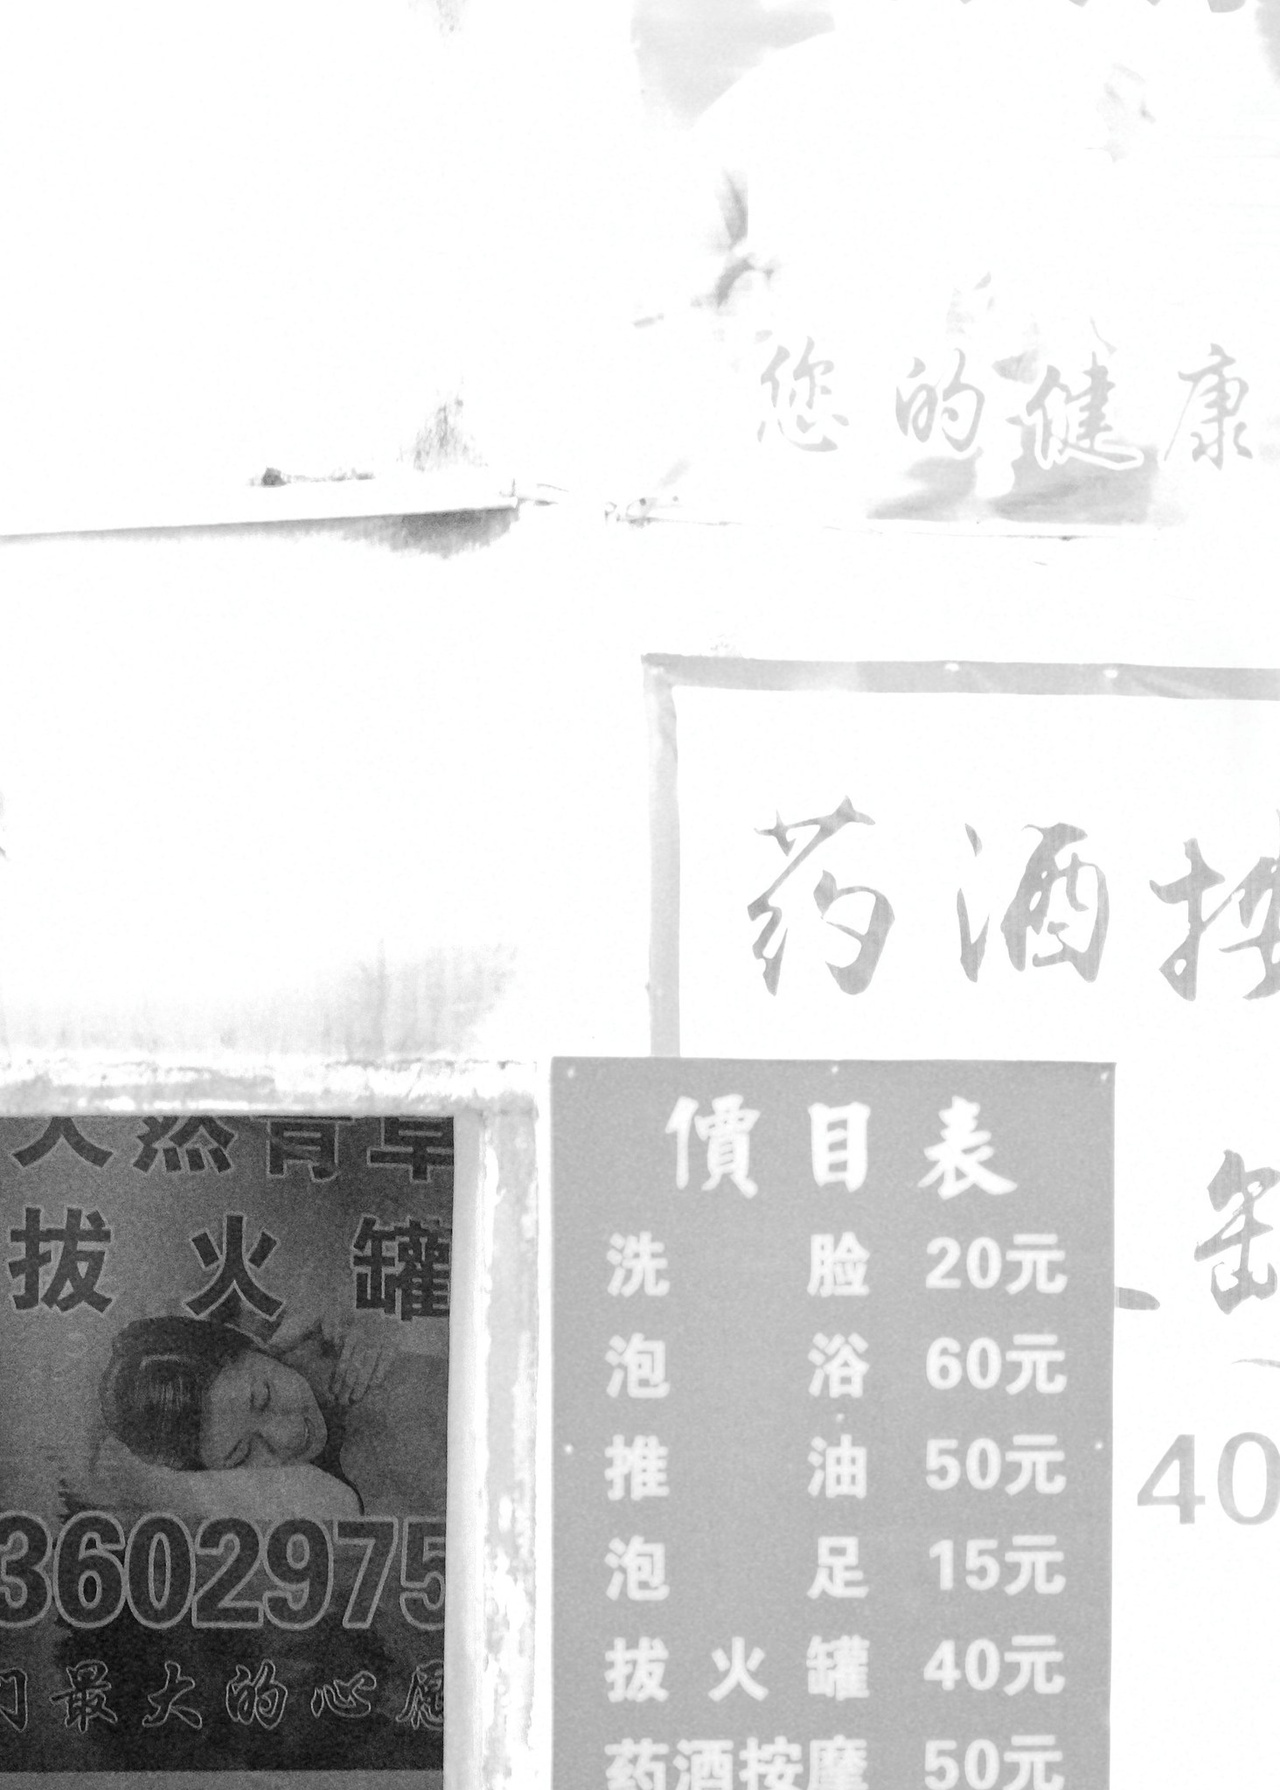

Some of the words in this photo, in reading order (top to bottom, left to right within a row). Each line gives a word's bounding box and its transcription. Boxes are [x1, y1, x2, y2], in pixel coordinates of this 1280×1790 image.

[757, 338, 1254, 470] 您的健康
[665, 1093, 1018, 1201] 價目表
[7, 1205, 452, 1322] 拔火罐
[925, 1233, 1068, 1295] 20元
[925, 1332, 1068, 1395] 60元
[926, 1434, 1067, 1496] 50元
[1137, 1432, 1280, 1526] 40
[928, 1534, 1066, 1595] 15元
[605, 1634, 870, 1702] 拔火罐
[923, 1634, 1066, 1696] 40元
